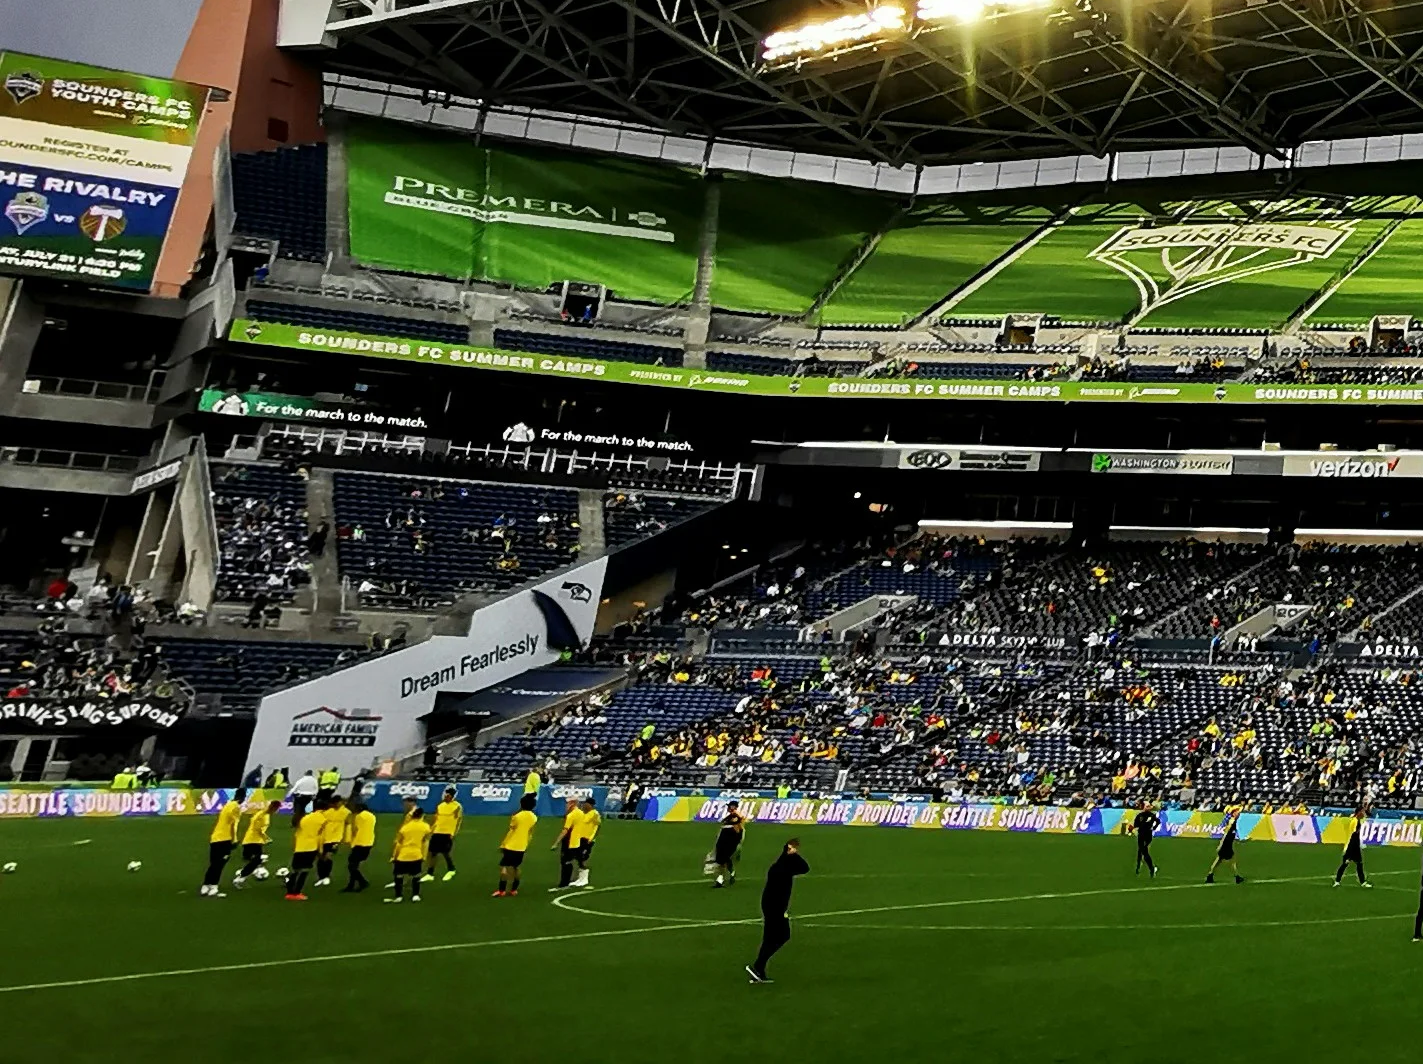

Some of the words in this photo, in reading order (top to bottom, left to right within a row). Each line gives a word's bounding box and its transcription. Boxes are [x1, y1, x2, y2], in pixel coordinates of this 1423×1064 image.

[51, 88, 117, 107] YOUTH
[121, 100, 192, 119] CAMPS
[52, 79, 160, 104] SOUNDERS
[165, 97, 192, 110] FC
[43, 137, 110, 153] REGISTER
[113, 148, 129, 156] AT
[43, 177, 166, 207] RIVALRY
[393, 176, 604, 219] PREMERA
[1295, 236, 1328, 249] FC
[298, 332, 411, 357] SOUNDERS
[418, 345, 442, 360] FC
[449, 349, 533, 371] SUMMER
[540, 358, 605, 376] CAMPS
[828, 383, 910, 397] SOUNDERS
[915, 384, 936, 396] FC
[939, 385, 1003, 397] SUMMER
[1008, 385, 1061, 398] CAMPS
[1256, 388, 1340, 401] SOUNDERS
[1343, 388, 1364, 401] FC
[256, 402, 279, 416] For
[281, 404, 302, 418] the
[306, 407, 345, 423] march
[348, 410, 360, 422] to
[363, 411, 385, 424] the
[389, 414, 428, 429] match.
[541, 429, 561, 442] For
[564, 430, 586, 444] the
[589, 434, 619, 447] march
[621, 435, 634, 447] to
[636, 436, 656, 449] the
[658, 439, 694, 452] match.
[1309, 458, 1389, 478] verizon
[953, 635, 996, 647] DELTA
[1375, 645, 1419, 656] DELTA
[401, 665, 455, 699] Dream
[461, 633, 538, 677] Fearlessly
[292, 723, 342, 735] AMERICAN
[345, 723, 379, 735] FAMILY
[293, 737, 372, 747] INSURANCE
[390, 782, 430, 798] slalom
[471, 783, 512, 798] slalom
[551, 782, 593, 799] slalom
[0, 792, 69, 815] SEATTLE
[74, 792, 161, 814] SOUNDERS
[166, 792, 186, 812] FC
[758, 802, 814, 821] MEDICAL
[817, 802, 849, 822] CARE
[853, 803, 917, 825] PROVIDER
[920, 804, 938, 824] OF
[941, 805, 997, 826] SEATTLE
[998, 807, 1069, 829] SOUNDERS
[1073, 810, 1092, 830] FC
[1166, 822, 1200, 836] Virginia
[1360, 822, 1423, 845] OFFICIAL
